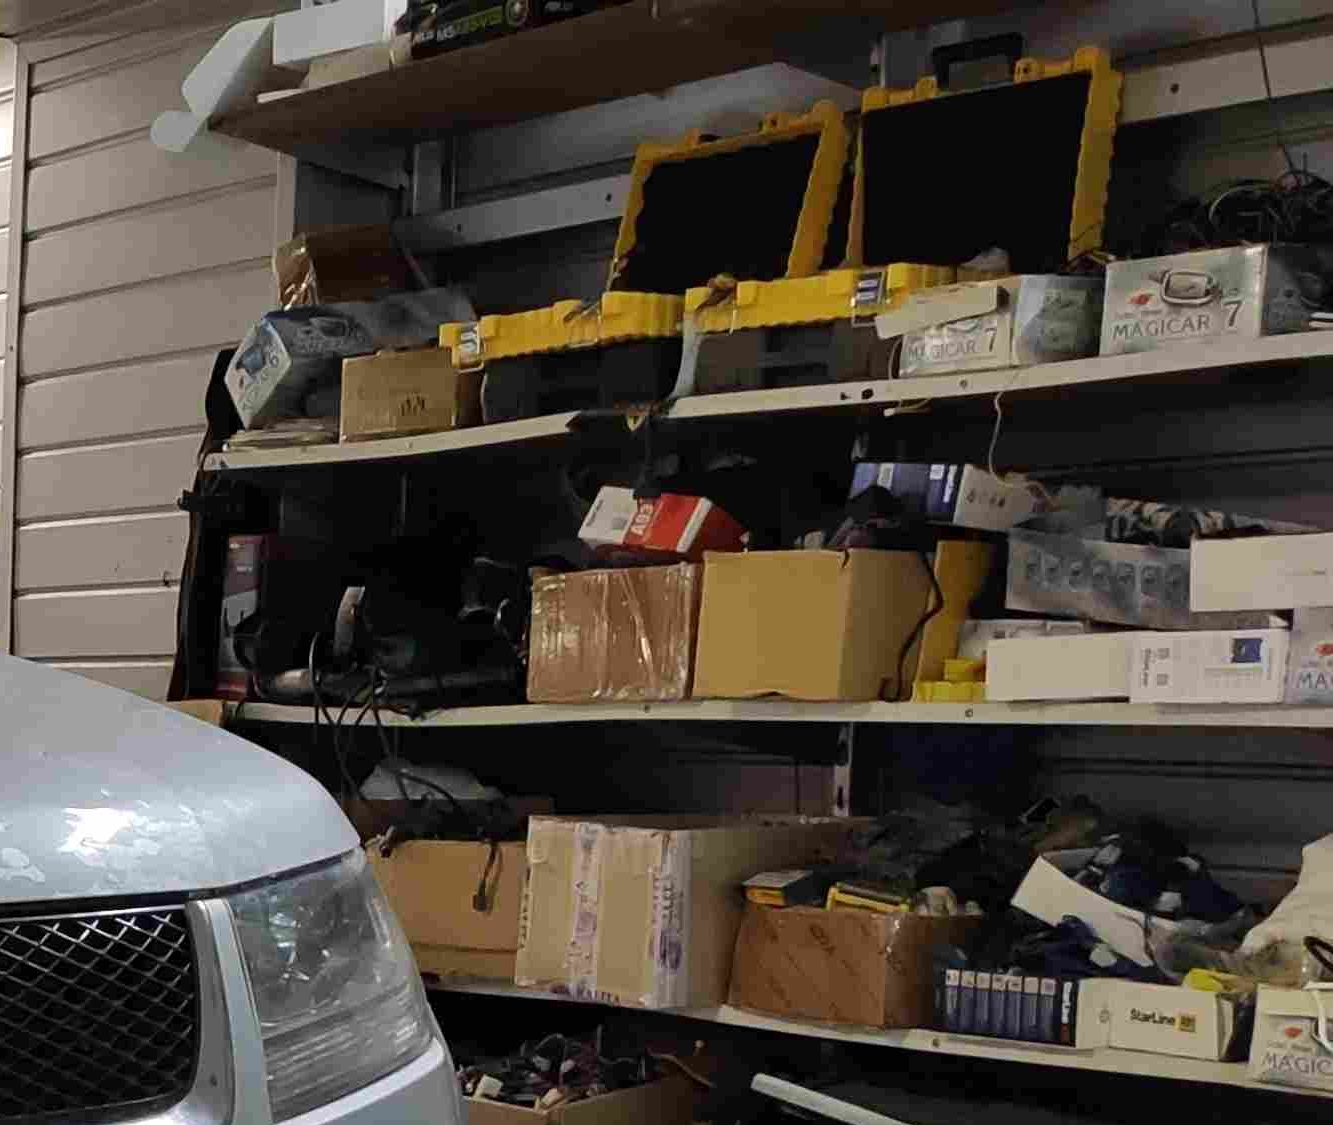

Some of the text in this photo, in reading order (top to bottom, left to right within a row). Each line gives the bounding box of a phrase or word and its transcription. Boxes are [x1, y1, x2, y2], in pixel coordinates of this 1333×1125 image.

[1112, 300, 1242, 341] MAGICAR 7
[983, 326, 998, 353] 7
